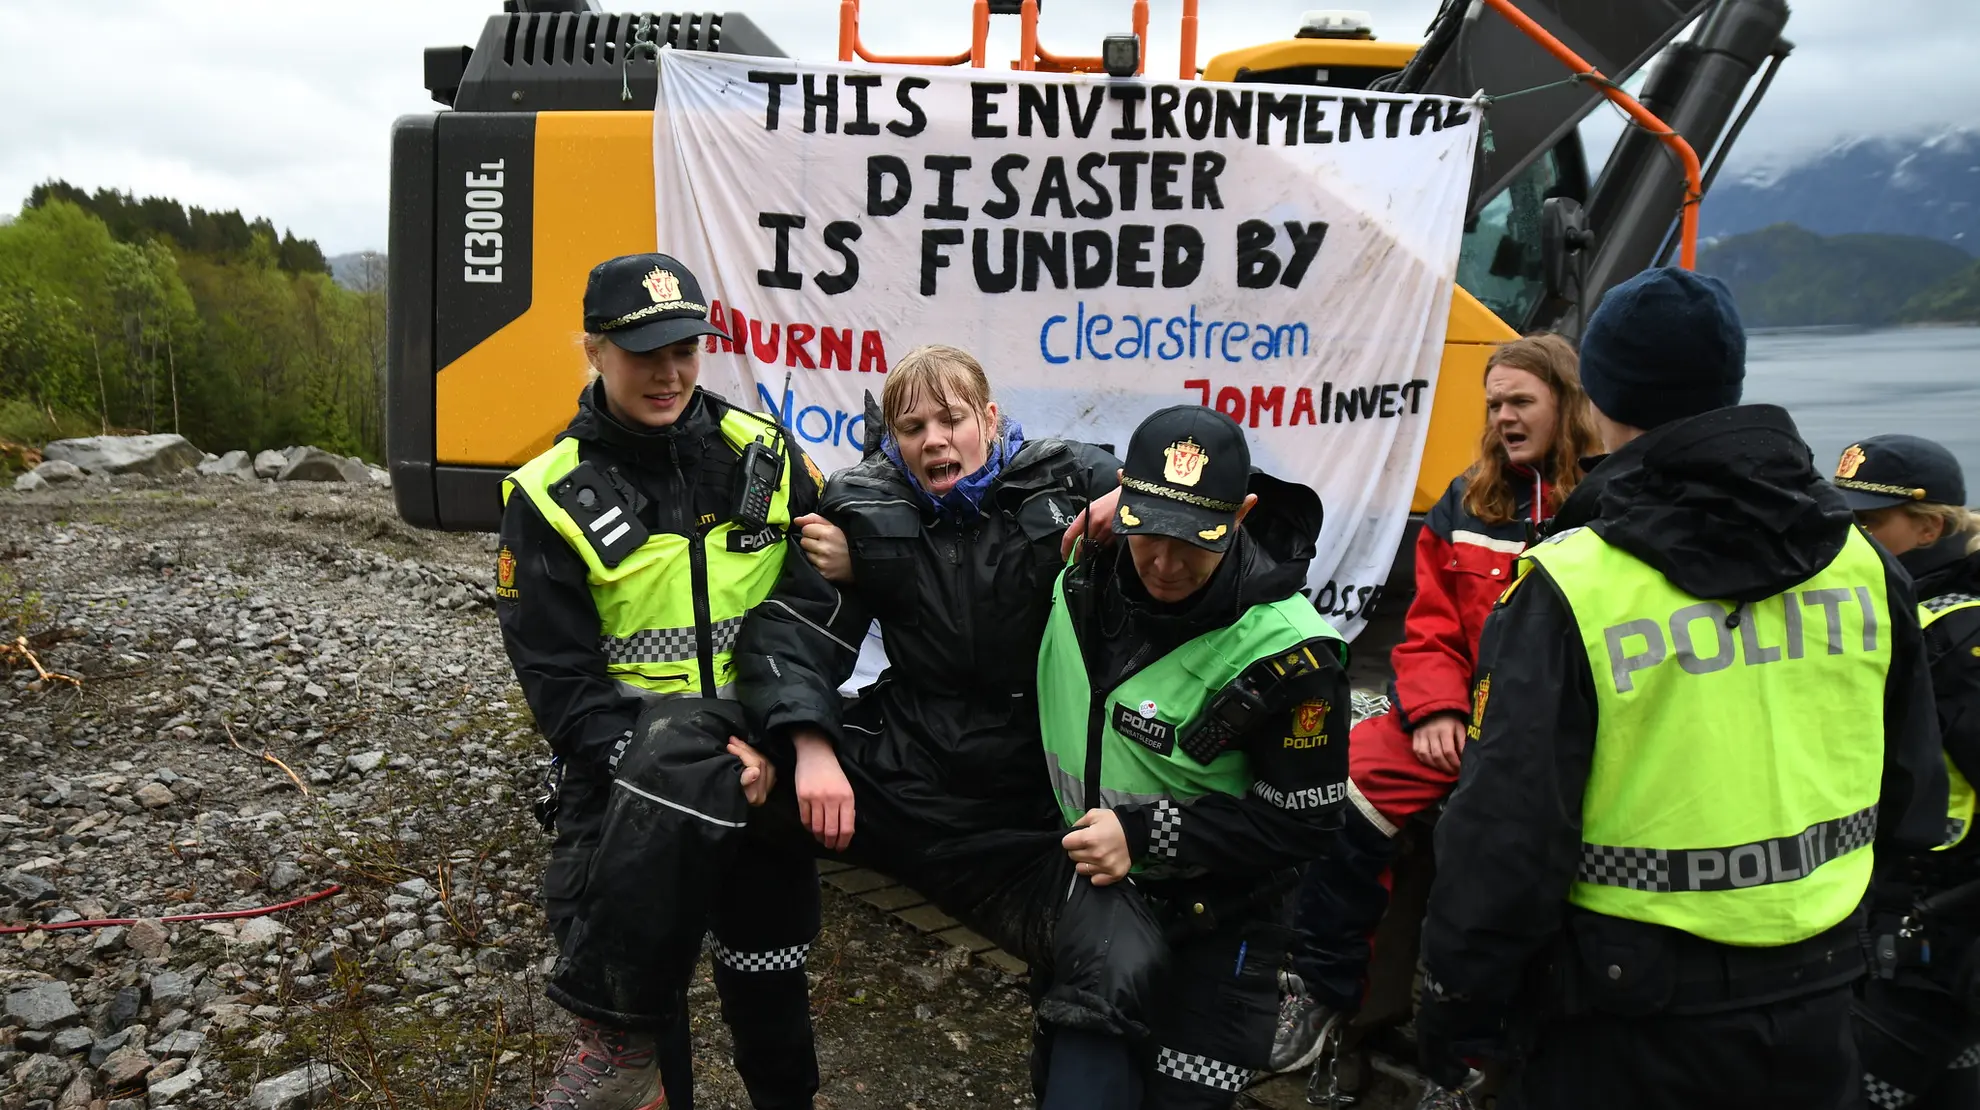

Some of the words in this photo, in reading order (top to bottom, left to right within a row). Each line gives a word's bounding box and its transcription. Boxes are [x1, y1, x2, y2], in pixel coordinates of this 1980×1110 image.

[747, 70, 931, 139] THIS
[970, 80, 1473, 146] ENVIRONMENTAL
[866, 150, 1228, 222] DISASTER
[757, 211, 863, 296] IS
[919, 223, 1206, 297] FUNDED
[1236, 219, 1329, 290] BY
[1603, 585, 1878, 695] POLITI
[1121, 711, 1167, 739] POLITI
[1283, 734, 1328, 749] POLITI
[1252, 779, 1348, 810] INNSATSLED
[1687, 822, 1829, 891] POLITI
